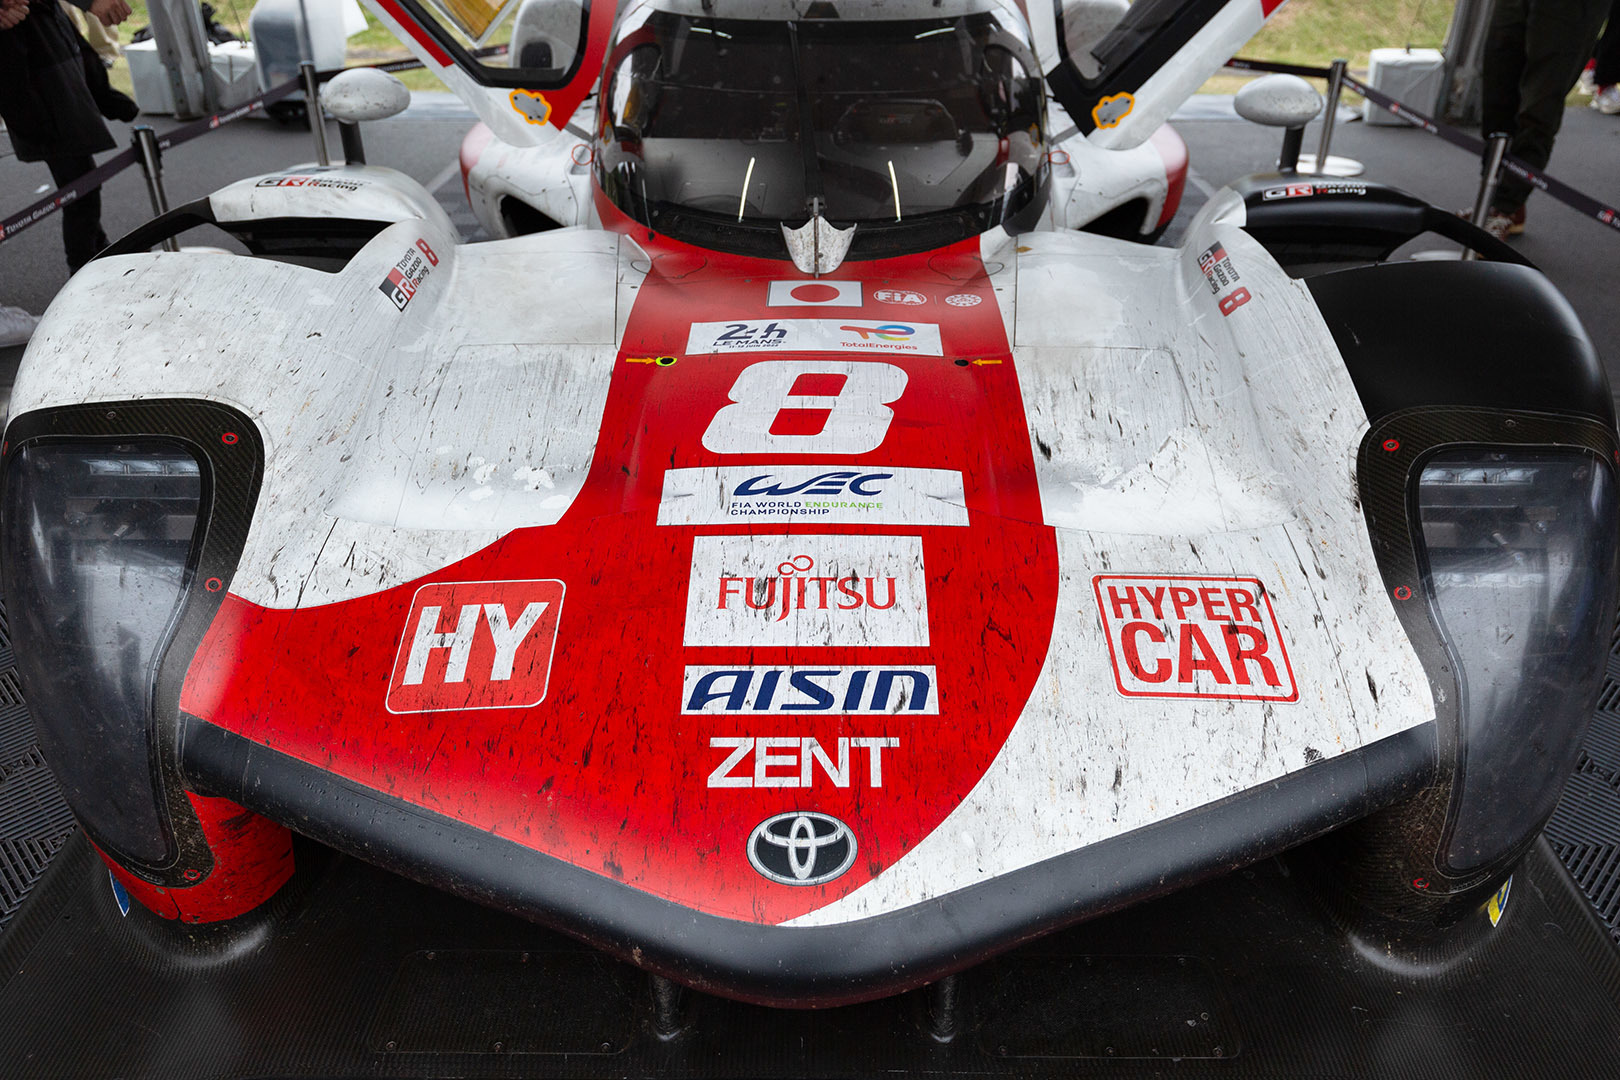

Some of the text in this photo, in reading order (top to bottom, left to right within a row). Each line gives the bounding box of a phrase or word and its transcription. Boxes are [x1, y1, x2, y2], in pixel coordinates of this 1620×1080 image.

[307, 182, 358, 191] Racing
[1264, 184, 1313, 200] GR
[1316, 187, 1366, 195] Racing
[396, 248, 416, 270] TOYOTA
[416, 238, 439, 267] 8
[405, 257, 422, 279] GAZOO
[412, 265, 430, 288] Racing
[1222, 257, 1240, 282] TOYOTA
[1206, 270, 1220, 295] Racing
[1218, 286, 1252, 317] 8
[840, 342, 918, 350] TotalEnergies
[701, 360, 909, 454] 8
[733, 471, 893, 496] WEC
[716, 555, 896, 622] FUJITSU
[1107, 586, 1263, 622] HYPER
[402, 602, 550, 686] HY
[1121, 621, 1284, 687] CAR
[686, 670, 930, 711] AISIN
[707, 737, 900, 788] ZENT
